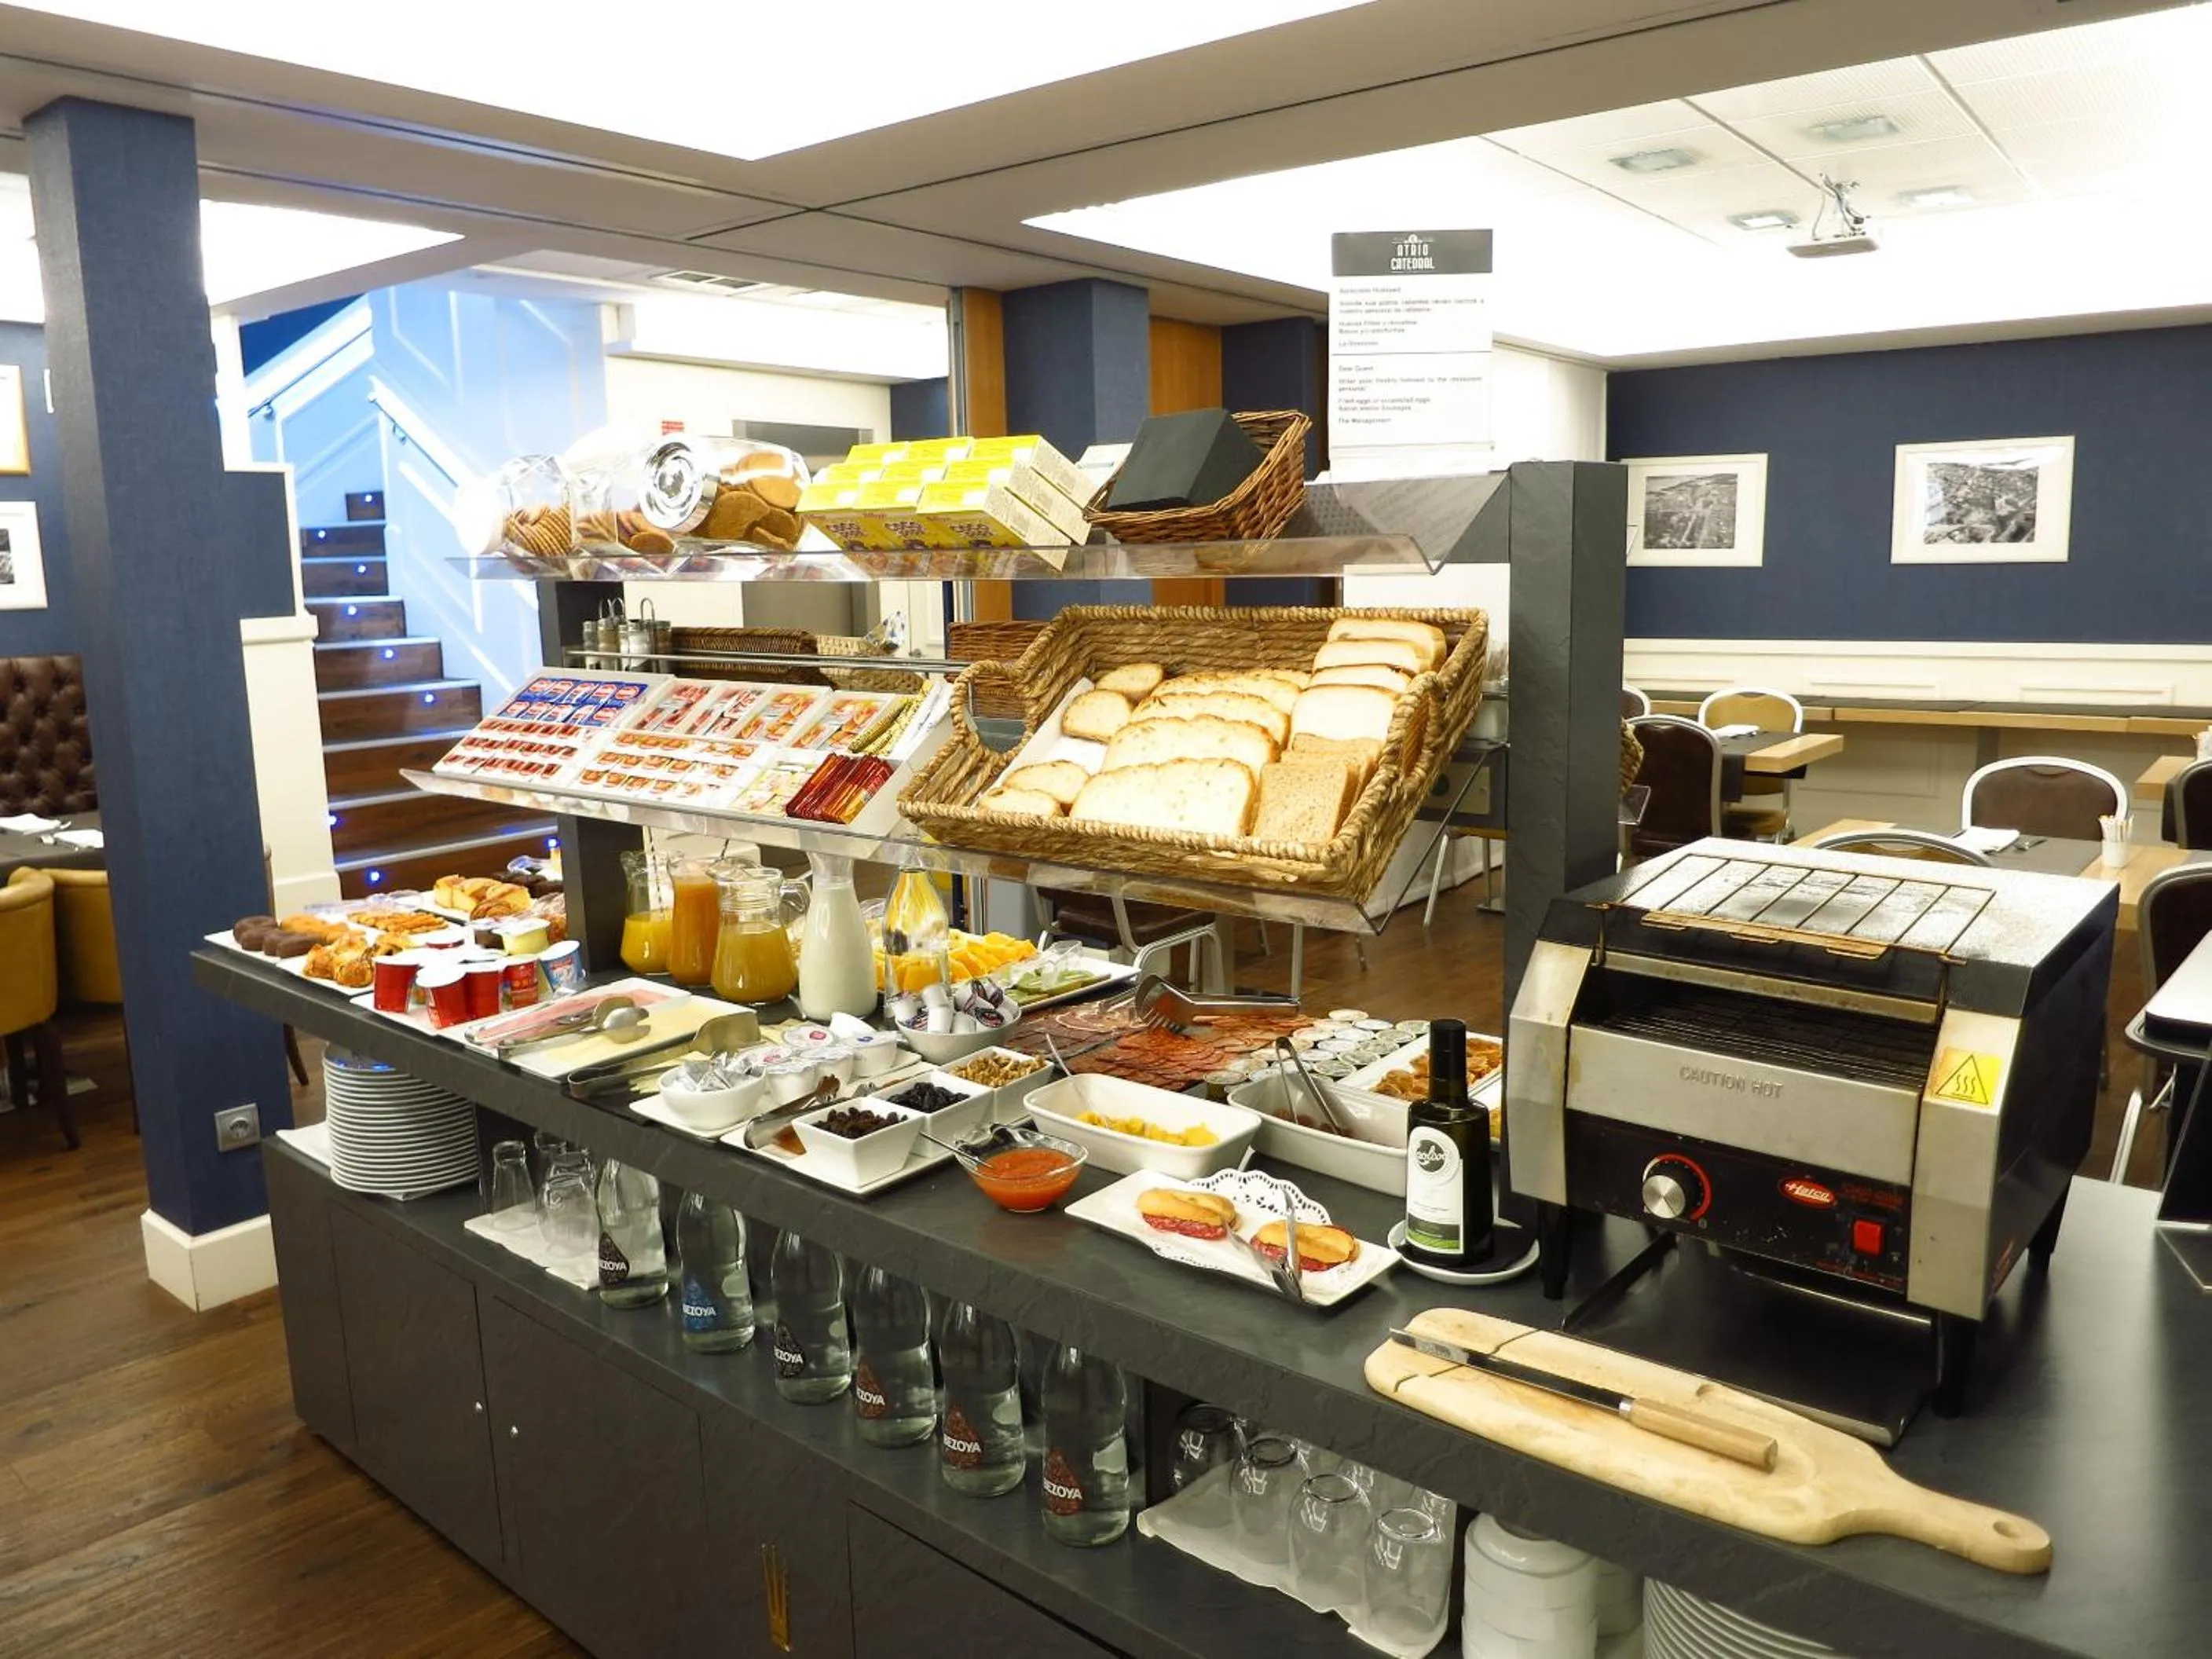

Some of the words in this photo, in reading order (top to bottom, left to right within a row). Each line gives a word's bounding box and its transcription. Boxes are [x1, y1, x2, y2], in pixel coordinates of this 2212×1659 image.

[1390, 257, 1436, 270] CATEDRAL
[1679, 1066, 1745, 1093] CAUTION
[1751, 1079, 1783, 1098] HOT
